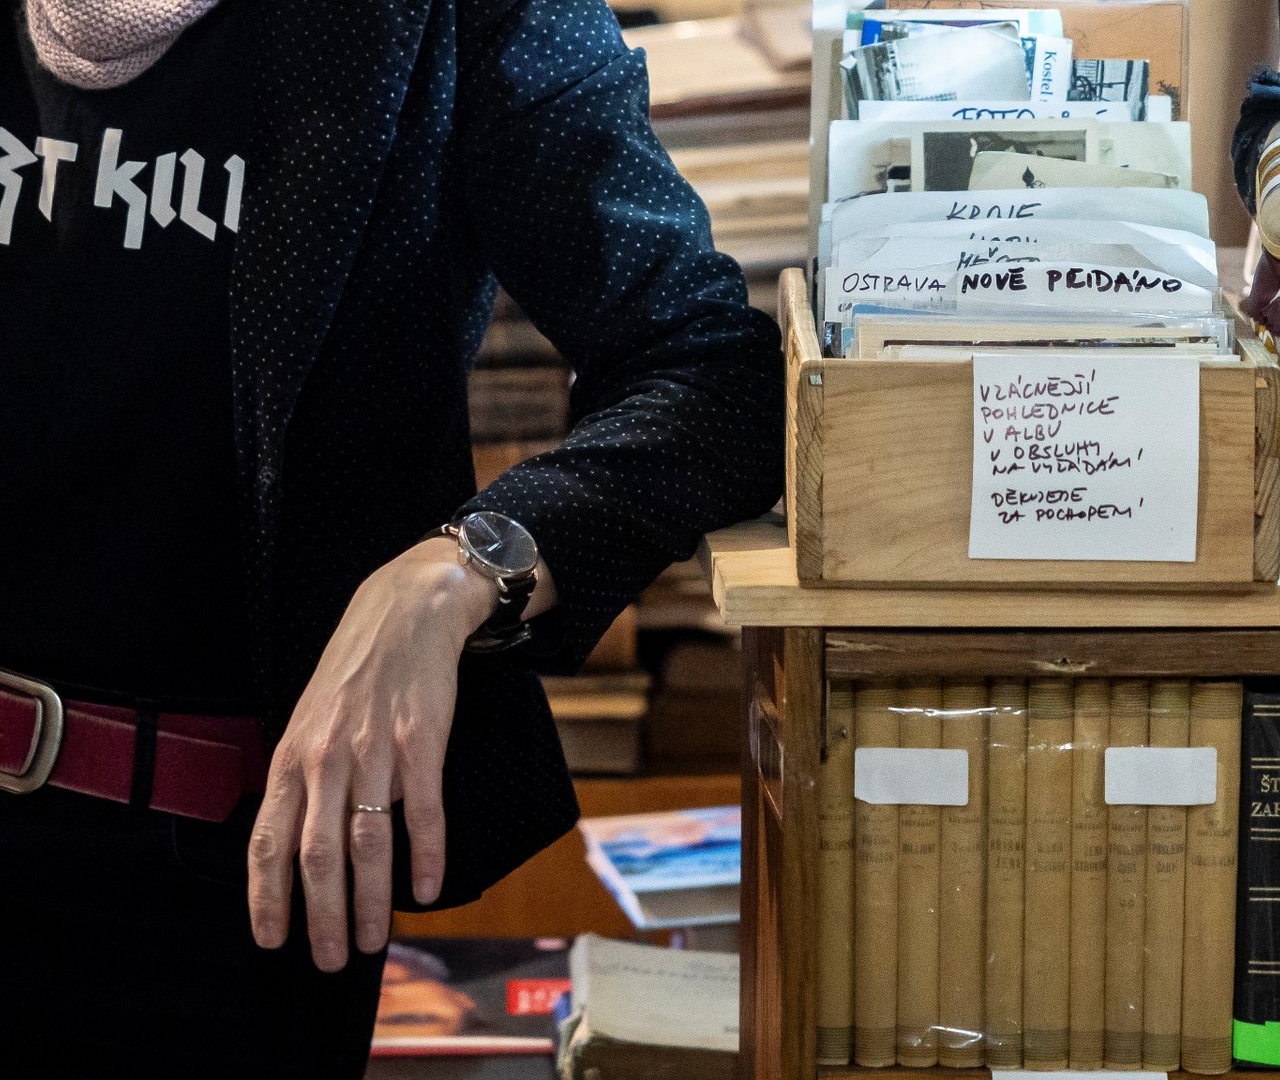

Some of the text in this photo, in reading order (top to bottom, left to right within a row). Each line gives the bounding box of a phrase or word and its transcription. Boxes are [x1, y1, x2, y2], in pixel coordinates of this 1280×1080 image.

[1040, 51, 1057, 95] Kostel
[842, 272, 946, 293] OSTRAVA
[980, 396, 1120, 424] POHLEDNICE
[983, 420, 1062, 443] V ALBU
[1014, 440, 1100, 460] OBSLUHY
[992, 464, 1025, 476] NA
[998, 510, 1025, 524] ZA
